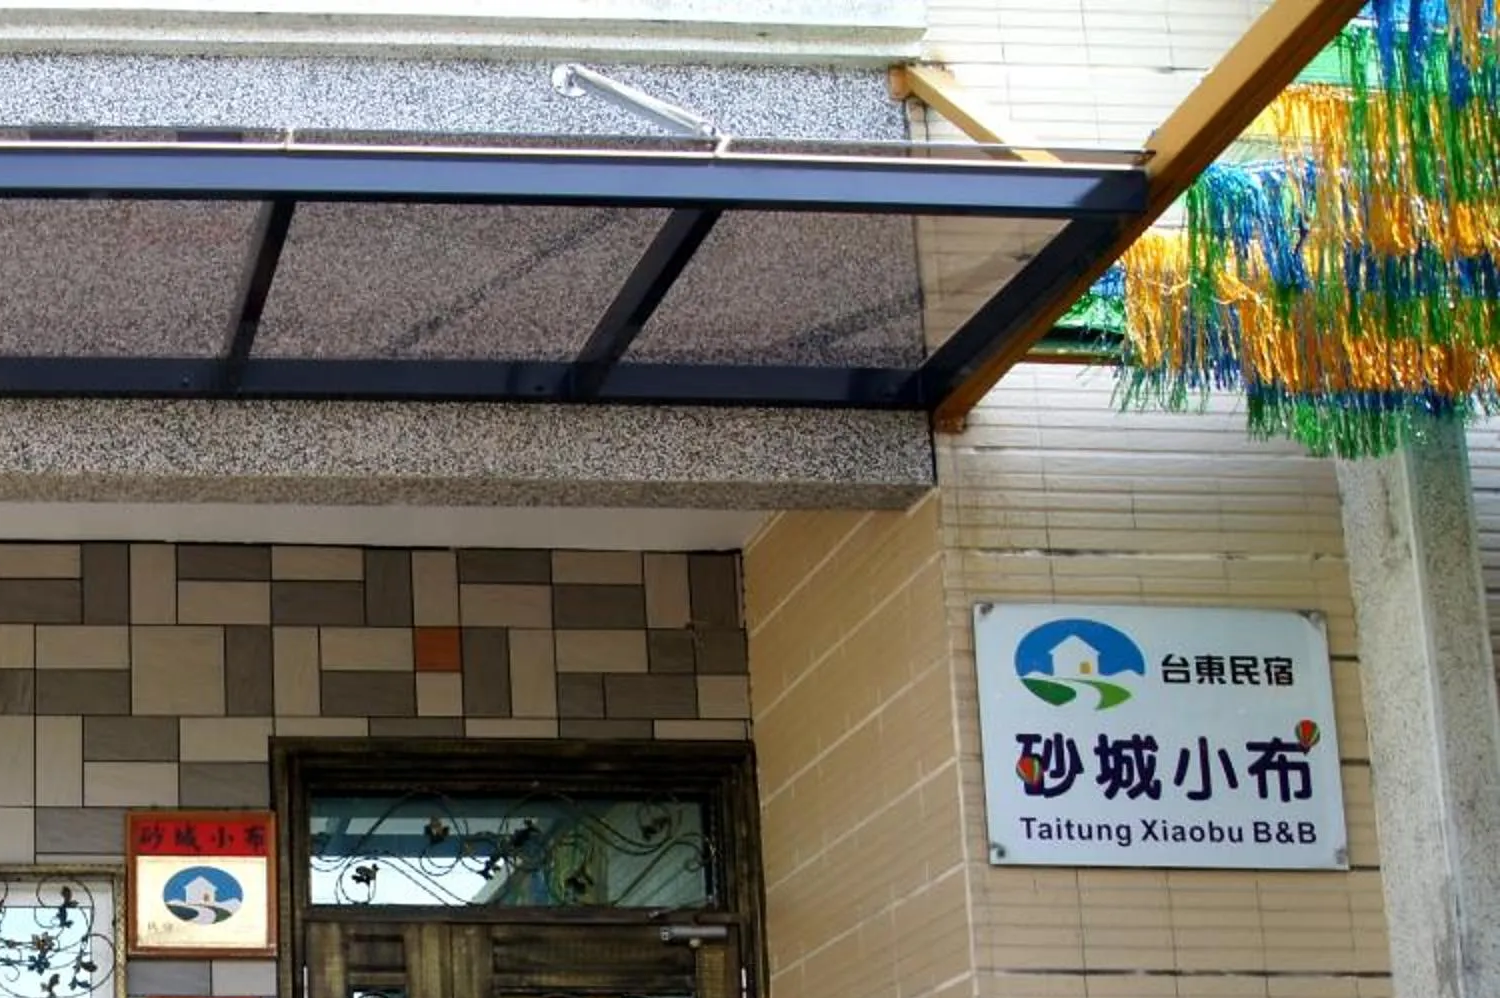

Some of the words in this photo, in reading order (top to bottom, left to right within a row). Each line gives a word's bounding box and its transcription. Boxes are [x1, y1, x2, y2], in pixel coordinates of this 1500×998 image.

[1161, 653, 1294, 686] 台東民宿
[1015, 732, 1313, 803] 砂城小布
[1019, 816, 1132, 847] Taitung
[1141, 819, 1244, 844] Xiaobu
[1254, 821, 1318, 845] B&B
